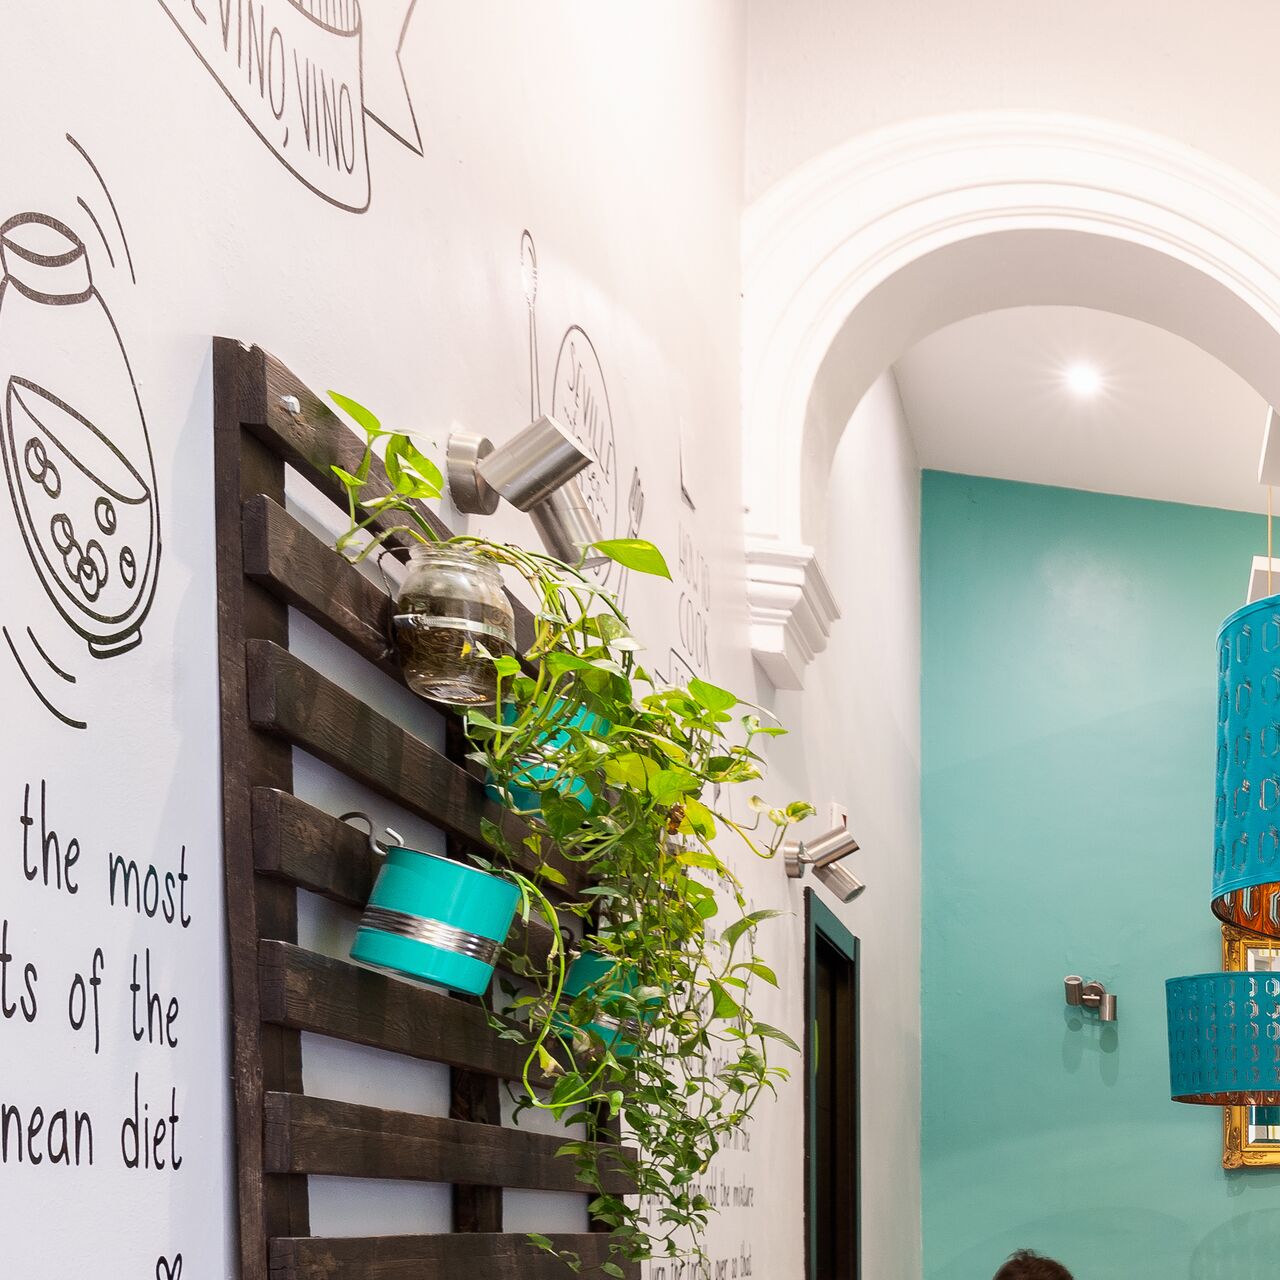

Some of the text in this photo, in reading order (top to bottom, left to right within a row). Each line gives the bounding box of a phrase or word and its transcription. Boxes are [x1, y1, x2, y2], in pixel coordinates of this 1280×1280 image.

[293, 48, 355, 174] VINO
[678, 592, 711, 680] COOK
[20, 779, 191, 928] the most
[68, 947, 104, 1054] of
[130, 947, 179, 1048] the
[120, 1072, 182, 1171] diet
[733, 1172, 754, 1207] mixture
[741, 1240, 752, 1278] that
